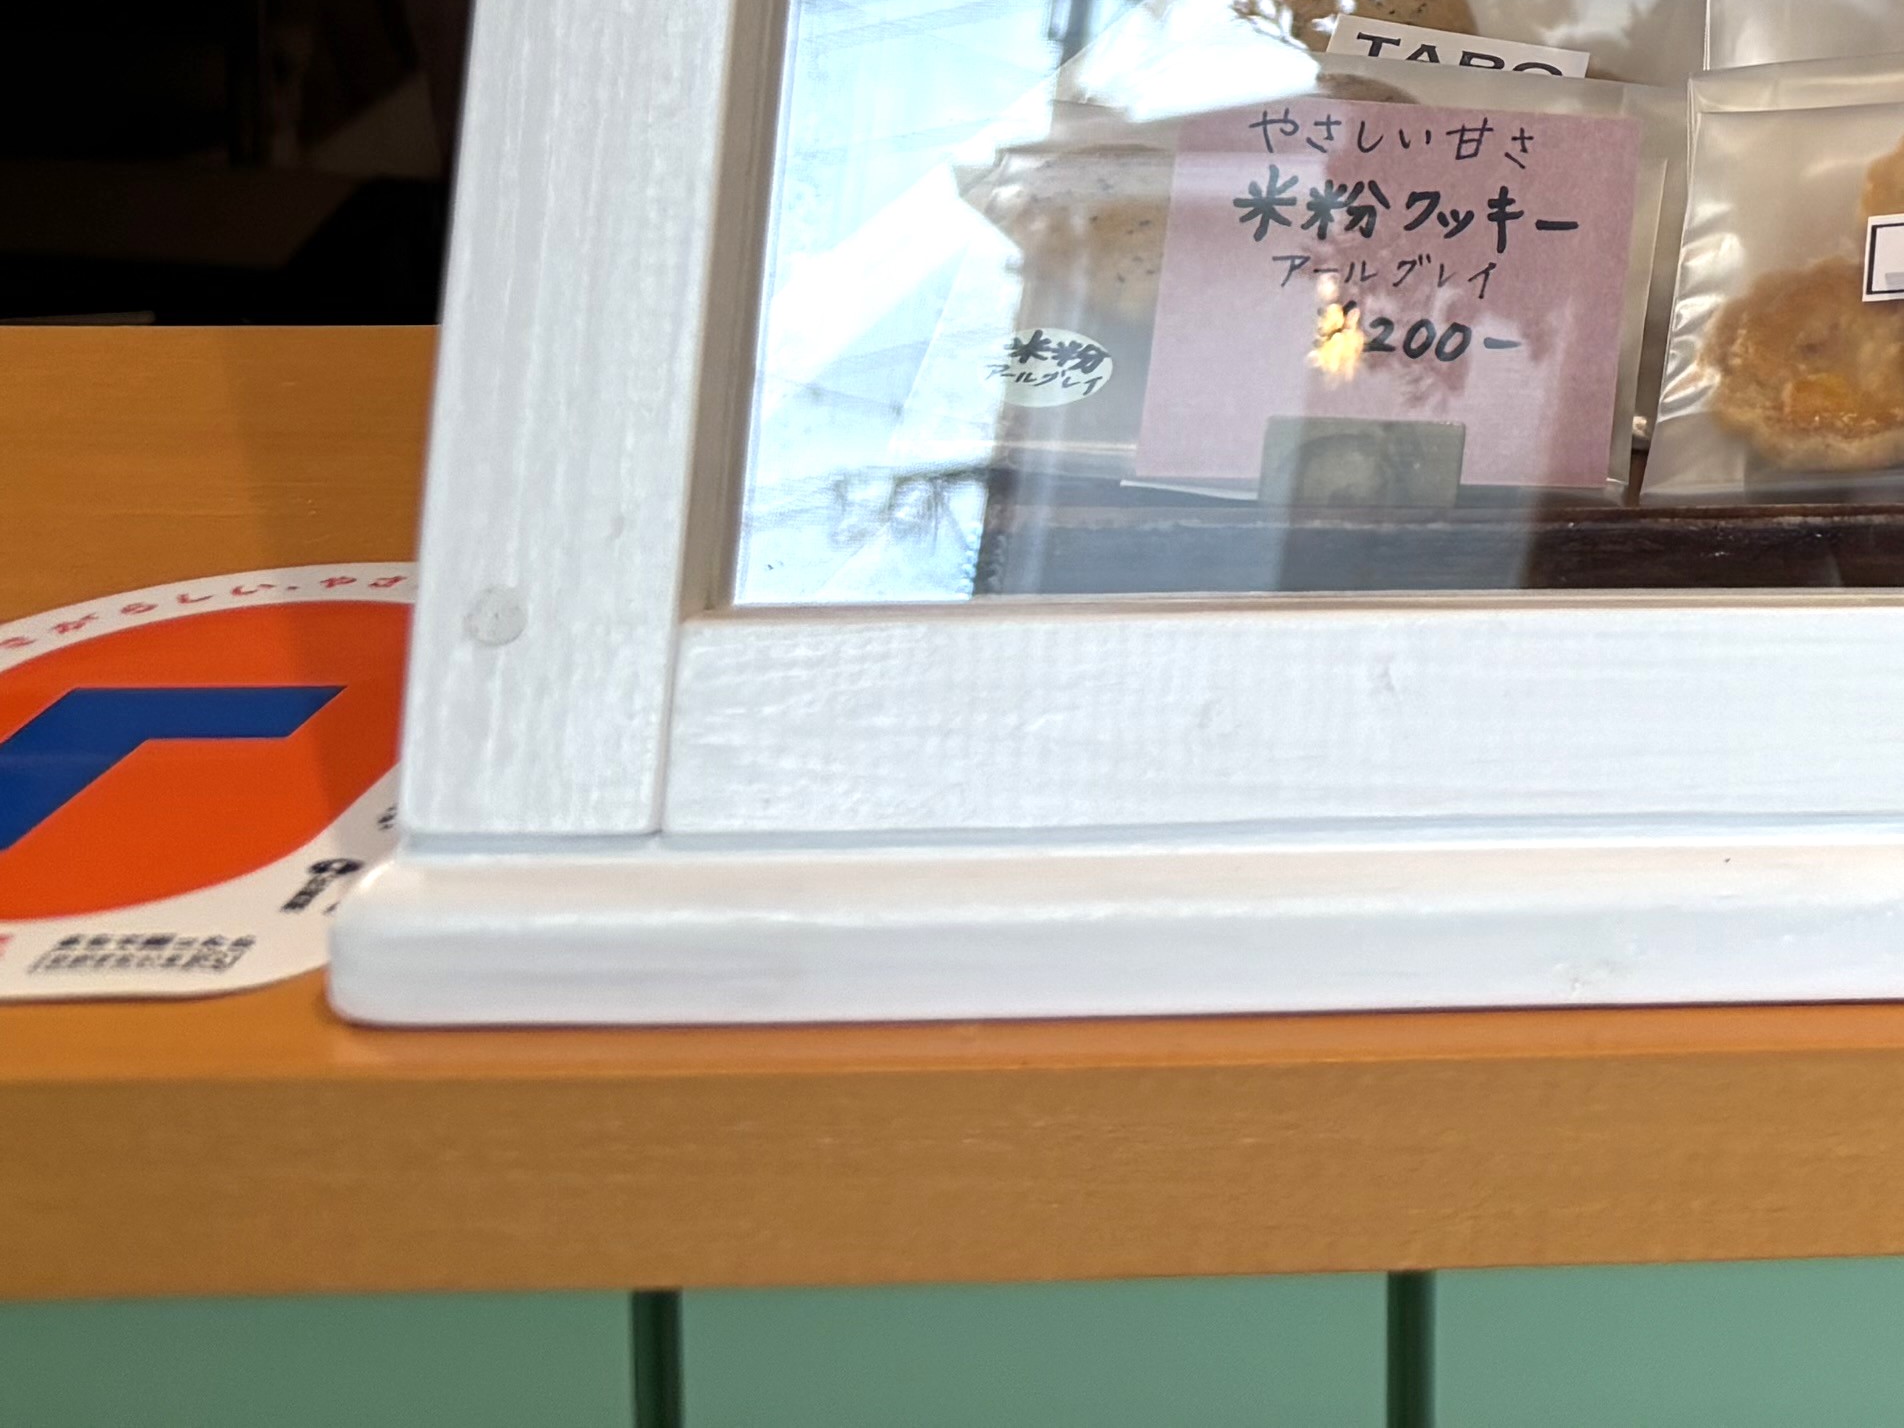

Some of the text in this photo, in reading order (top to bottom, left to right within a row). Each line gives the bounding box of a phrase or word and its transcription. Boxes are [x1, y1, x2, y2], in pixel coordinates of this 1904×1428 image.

[1248, 106, 1535, 170] やさしい甘さ
[1232, 163, 1581, 254] 米粉クッキー
[1271, 253, 1498, 300] アールグレイ
